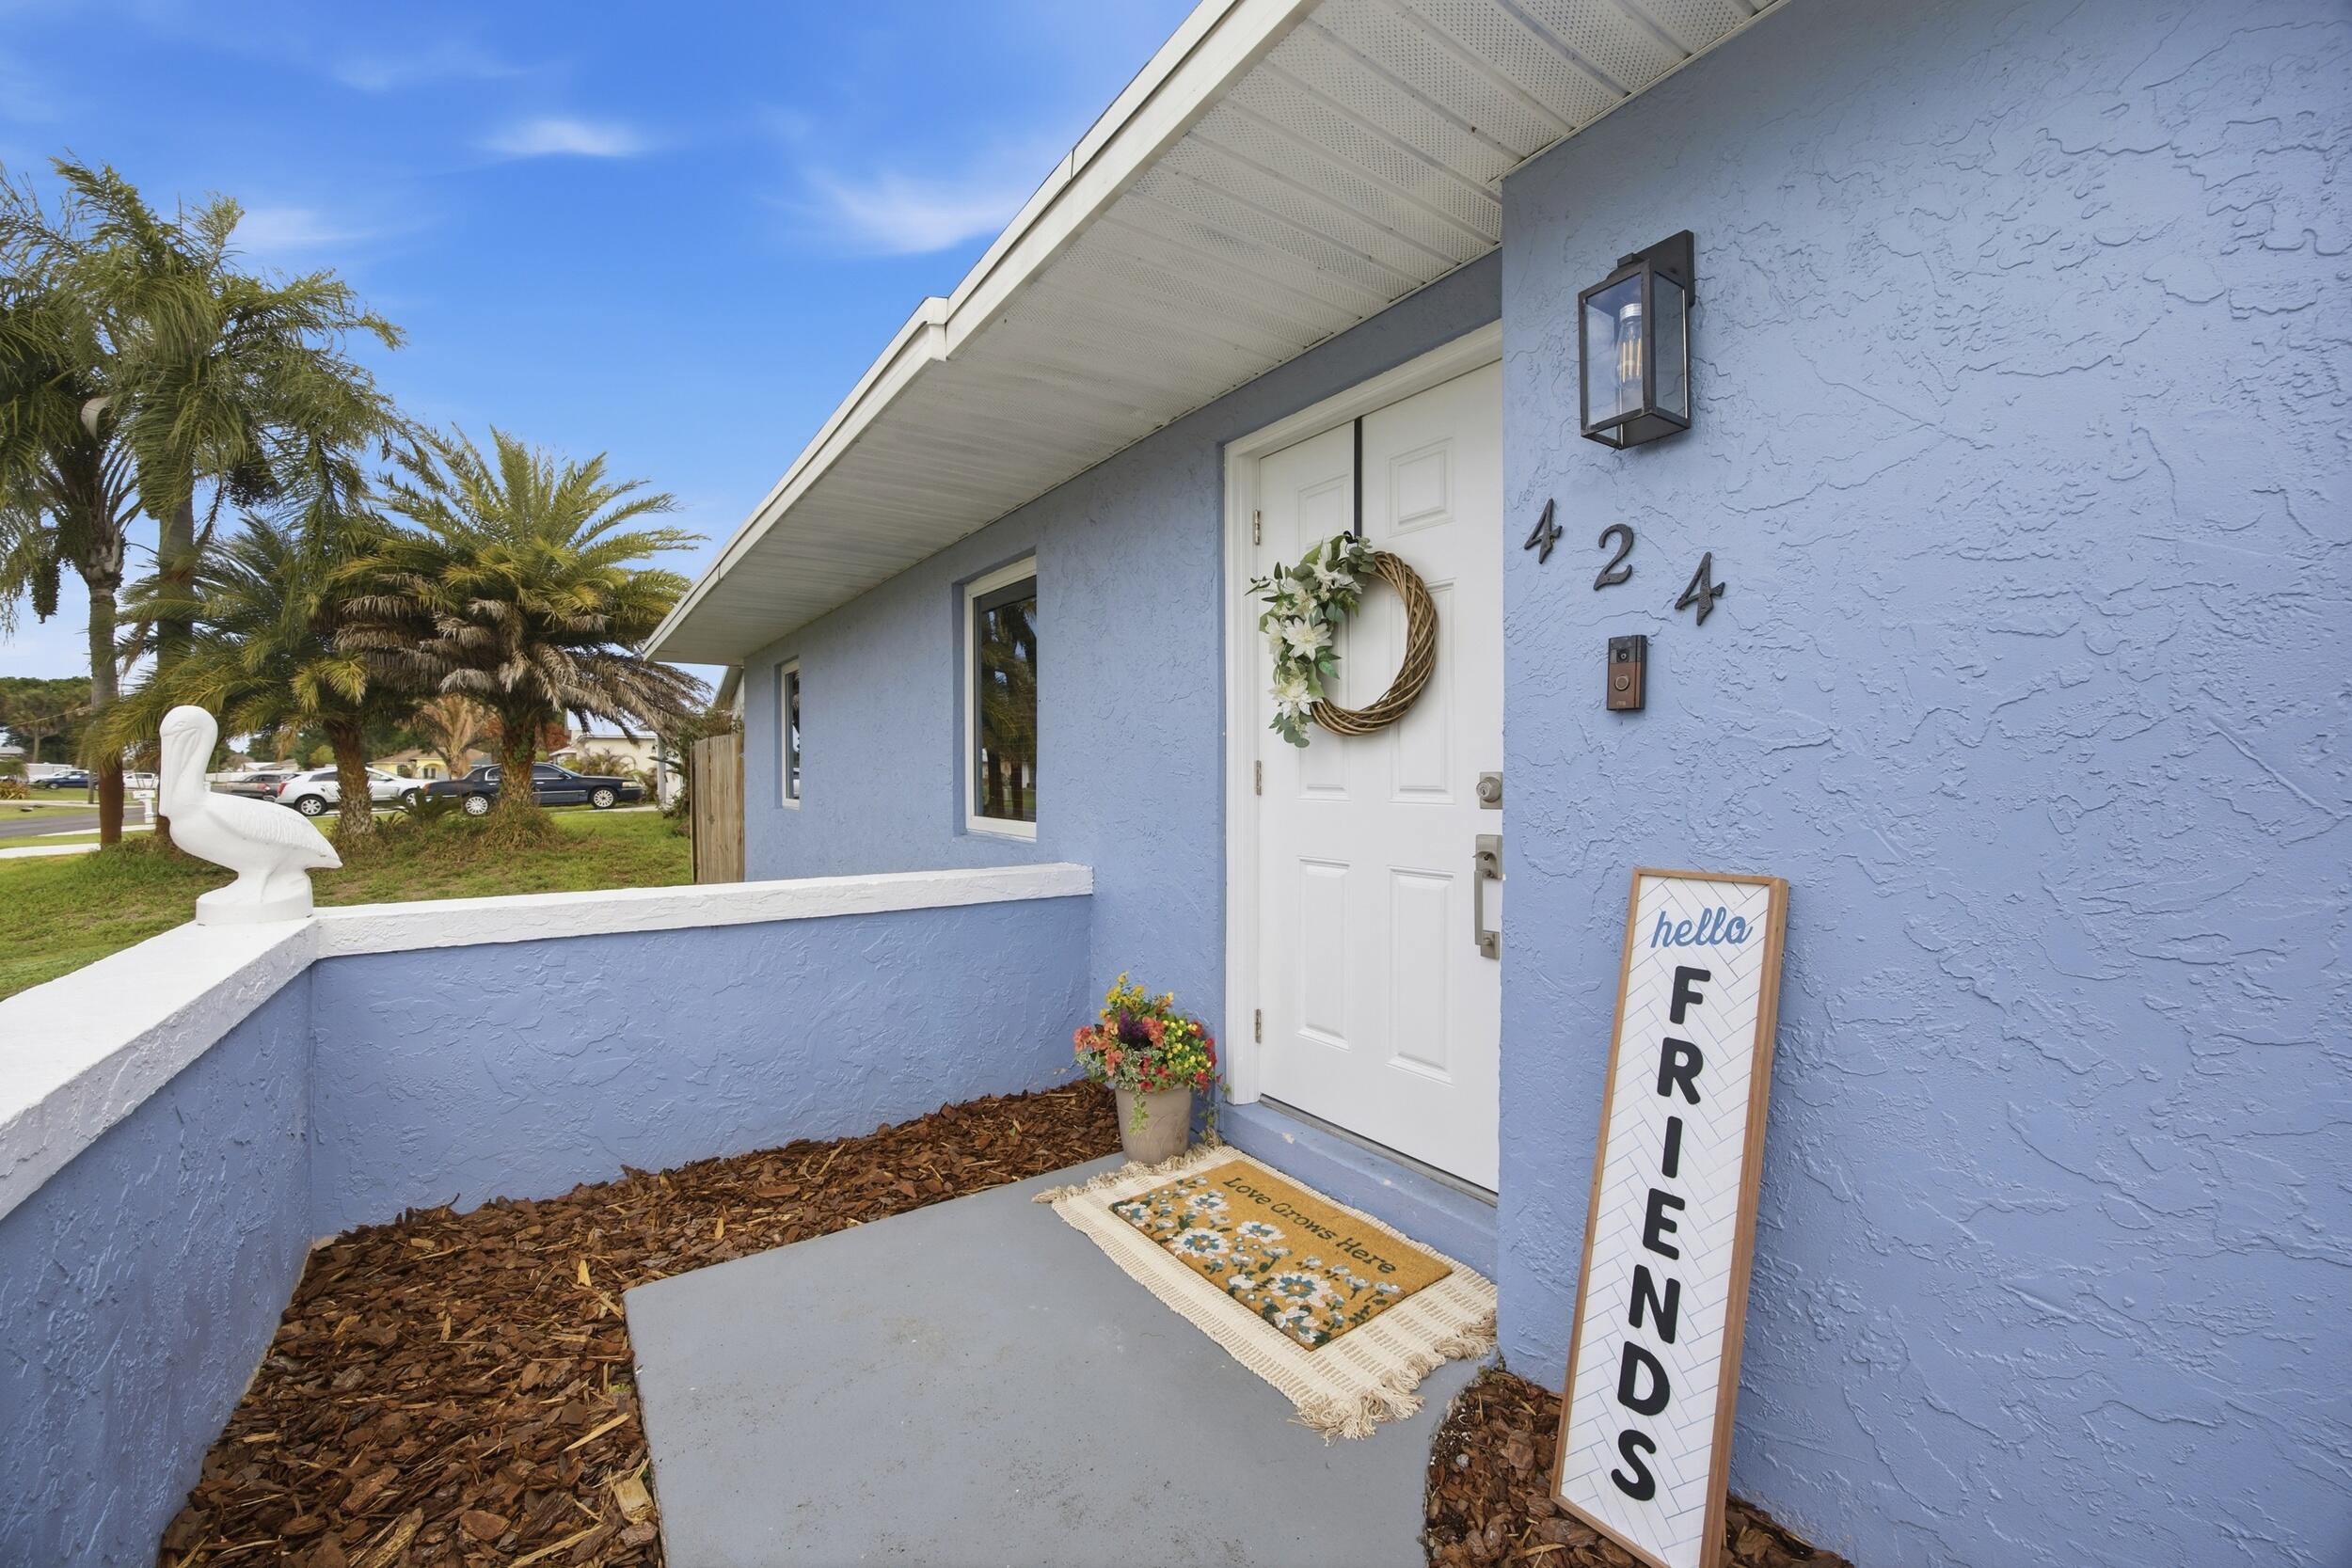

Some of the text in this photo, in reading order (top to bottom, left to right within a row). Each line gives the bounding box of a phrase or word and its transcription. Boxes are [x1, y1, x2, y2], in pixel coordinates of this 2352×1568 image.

[1523, 498, 1725, 626] 424
[1650, 906, 1754, 949] hello
[1222, 1177, 1396, 1275] Love Grows Here
[1611, 965, 1711, 1501] FRIENDS
